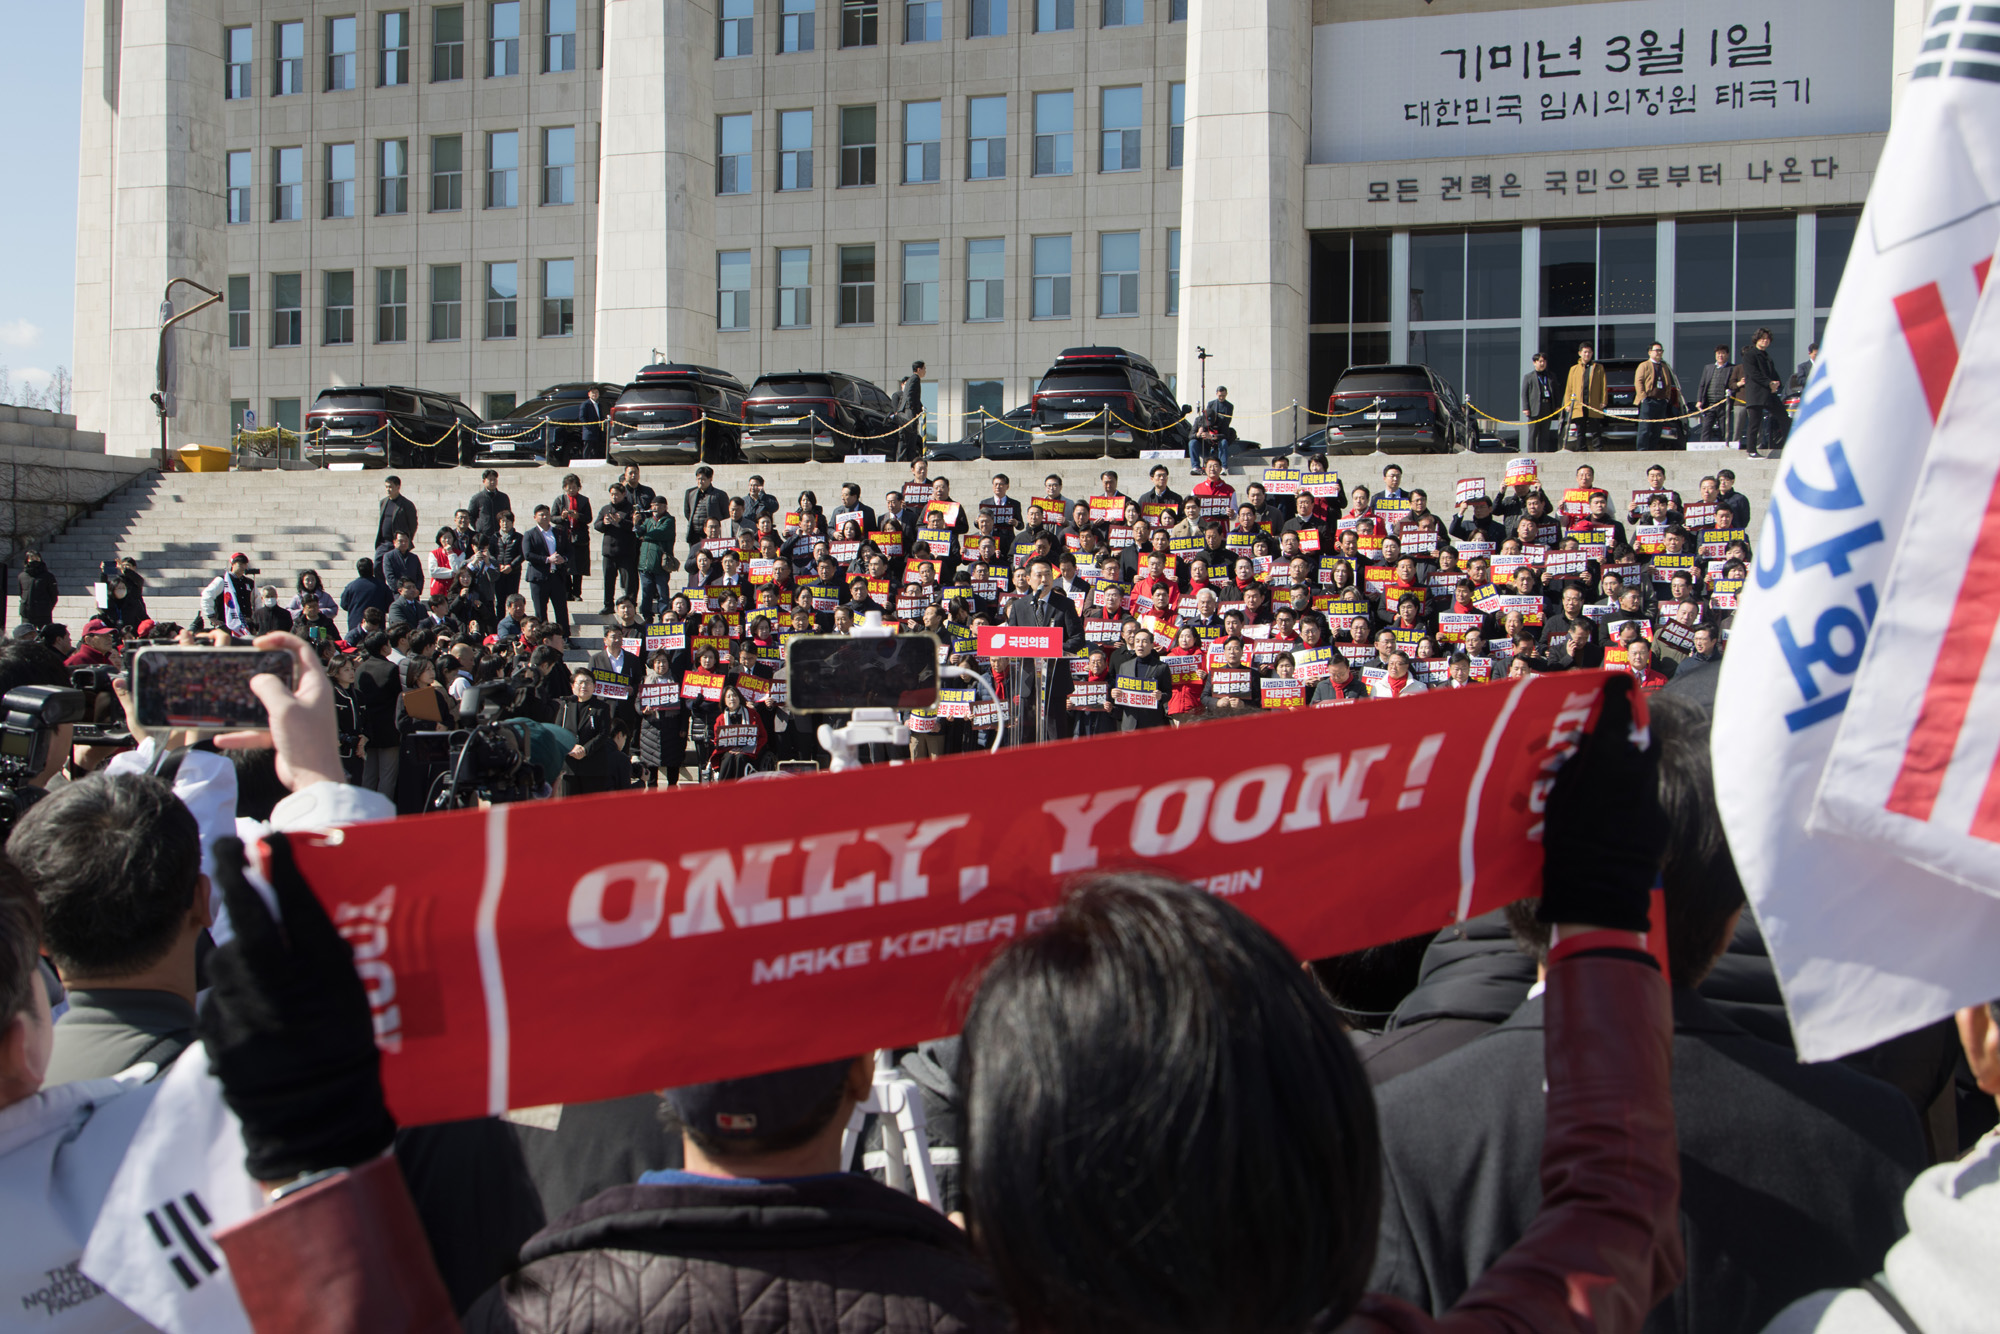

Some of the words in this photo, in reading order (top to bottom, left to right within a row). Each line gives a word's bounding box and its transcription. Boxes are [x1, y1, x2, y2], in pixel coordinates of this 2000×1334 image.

[1442, 37, 1581, 82] 기미년
[1606, 28, 1683, 76] 3월
[1711, 22, 1772, 67] 1일
[1404, 95, 1522, 128] 대한민국
[1540, 83, 1697, 121] 임시의정원
[1716, 78, 1811, 107] 태극기
[1368, 180, 1420, 203] 모든
[1442, 173, 1522, 201] 권력은
[1546, 162, 1722, 195] 국민으로부터
[1748, 156, 1839, 184] 나온다
[1264, 470, 1287, 481] 삼권분립
[1288, 470, 1299, 481] 파괴
[1506, 466, 1534, 477] 대한민국
[1302, 474, 1324, 484] 삼권분립
[1325, 473, 1337, 483] 파괴
[1467, 479, 1484, 489] 파괴
[905, 485, 920, 494] 사법
[1274, 482, 1298, 493] 중단하라!
[1467, 490, 1484, 500] 완성
[1054, 501, 1065, 512] 3법
[1091, 498, 1113, 508] 사법파괴
[1114, 497, 1124, 508] 3법
[1213, 497, 1229, 506] 파괴
[1376, 500, 1398, 510] 삼권분립
[1212, 507, 1228, 515] 완성
[1685, 506, 1703, 517] 사법
[1685, 517, 1703, 527] 독재
[918, 530, 938, 540] 삼권분립
[940, 532, 950, 542] 파괴
[1110, 528, 1126, 538] 사법
[1307, 530, 1318, 540] 3법
[1401, 534, 1417, 543] 사법
[1418, 533, 1437, 543] 파괴
[1593, 531, 1605, 543] 파괴
[1703, 530, 1729, 542] 삼권분립
[1731, 530, 1745, 541] 파괴
[704, 541, 718, 549] 사법
[719, 539, 736, 547] 파괴
[1110, 538, 1124, 548] 독재
[1170, 538, 1191, 549] 삼권분립
[1193, 537, 1205, 548] 파괴
[1227, 534, 1249, 545] 삼권분립
[830, 544, 844, 554] 사법
[1401, 544, 1418, 553] 독재
[1418, 543, 1437, 552] 완성
[1459, 552, 1491, 560] 대한민국
[1546, 554, 1565, 564] 사법
[1567, 551, 1586, 562] 파괴
[1653, 556, 1679, 567] 삼권분립
[1681, 556, 1694, 567] 파괴
[996, 567, 1008, 577] 파괴
[1215, 567, 1227, 577] 파괴
[1271, 566, 1287, 575] 사법
[1546, 565, 1565, 575] 독재
[1566, 562, 1586, 573] 완성
[1623, 564, 1640, 575] 파괴
[1366, 569, 1392, 580] 사법파괴
[1429, 575, 1446, 585] 사법
[1448, 574, 1467, 585] 파괴
[1492, 574, 1508, 584] 헌정
[1623, 575, 1640, 585] 완성
[1654, 570, 1666, 580] 당장
[878, 582, 888, 593] 3법
[980, 582, 996, 591] 파괴
[1483, 584, 1496, 597] 파괴
[683, 589, 704, 599] 삼권분립
[827, 588, 839, 597] 파괴
[961, 588, 972, 598] 파괴
[781, 595, 791, 604] 3법
[898, 599, 910, 608] 사법
[912, 599, 929, 607] 파괴
[1180, 598, 1197, 607] 사법
[1501, 597, 1522, 605] 사법파괴
[1715, 596, 1727, 607] 당장
[766, 608, 778, 618] 파괴
[1329, 603, 1354, 614] 삼권분립
[1356, 602, 1368, 613] 파괴
[728, 614, 739, 624] 3법
[898, 610, 912, 618] 독재
[1440, 615, 1462, 623] 사법파괴
[647, 625, 670, 636] 삼권분립
[672, 624, 684, 634] 파괴
[1086, 621, 1103, 632] 사법
[1105, 622, 1122, 631] 파괴
[1164, 624, 1178, 637] 3법
[1666, 623, 1684, 637] 사법
[1085, 632, 1103, 642] 독재
[1103, 632, 1121, 641] 완성
[1207, 627, 1221, 638] 파괴
[647, 638, 659, 649] 당장
[718, 638, 730, 648] 3법
[1008, 636, 1049, 649] 국민의힘
[1660, 631, 1680, 646] 독재
[1255, 642, 1273, 652] 사법
[1274, 640, 1293, 651] 파괴
[1356, 645, 1375, 656] 파괴
[768, 648, 780, 658] 파괴
[1317, 648, 1332, 660] 파괴
[1430, 660, 1448, 671] 파괴
[594, 669, 615, 685] 삼권분립
[616, 675, 629, 686] 파괴
[685, 673, 711, 687] 사법파괴
[712, 676, 724, 687] 3법
[1212, 672, 1229, 682] 사법
[1230, 671, 1250, 682] 파괴
[739, 675, 763, 692] 사법파괴
[1088, 684, 1107, 694] 파괴
[1117, 677, 1142, 691] 삼권분립
[1143, 680, 1157, 691] 파괴
[1213, 682, 1229, 694] 독재
[1230, 682, 1250, 693] 완성
[1262, 680, 1283, 689] 사법파괴
[1284, 680, 1296, 688] 악법
[641, 686, 659, 697] 사법
[660, 684, 679, 694] 파괴
[963, 689, 975, 701] 파괴
[1266, 689, 1301, 698] 대한민국
[641, 696, 659, 706] 독재
[660, 694, 679, 704] 완성
[1130, 694, 1156, 706] 중단하라!
[1264, 698, 1281, 707] 헌정
[1283, 697, 1303, 706] 수호!
[973, 703, 989, 715] 사법
[973, 716, 989, 726] 독재
[719, 727, 737, 737] 사법
[739, 726, 758, 736] 파괴
[718, 737, 737, 747] 독재
[738, 736, 757, 746] 완성
[566, 813, 989, 951] ONLY,
[752, 939, 871, 985] MAKE
[880, 913, 1018, 959] KOREA
